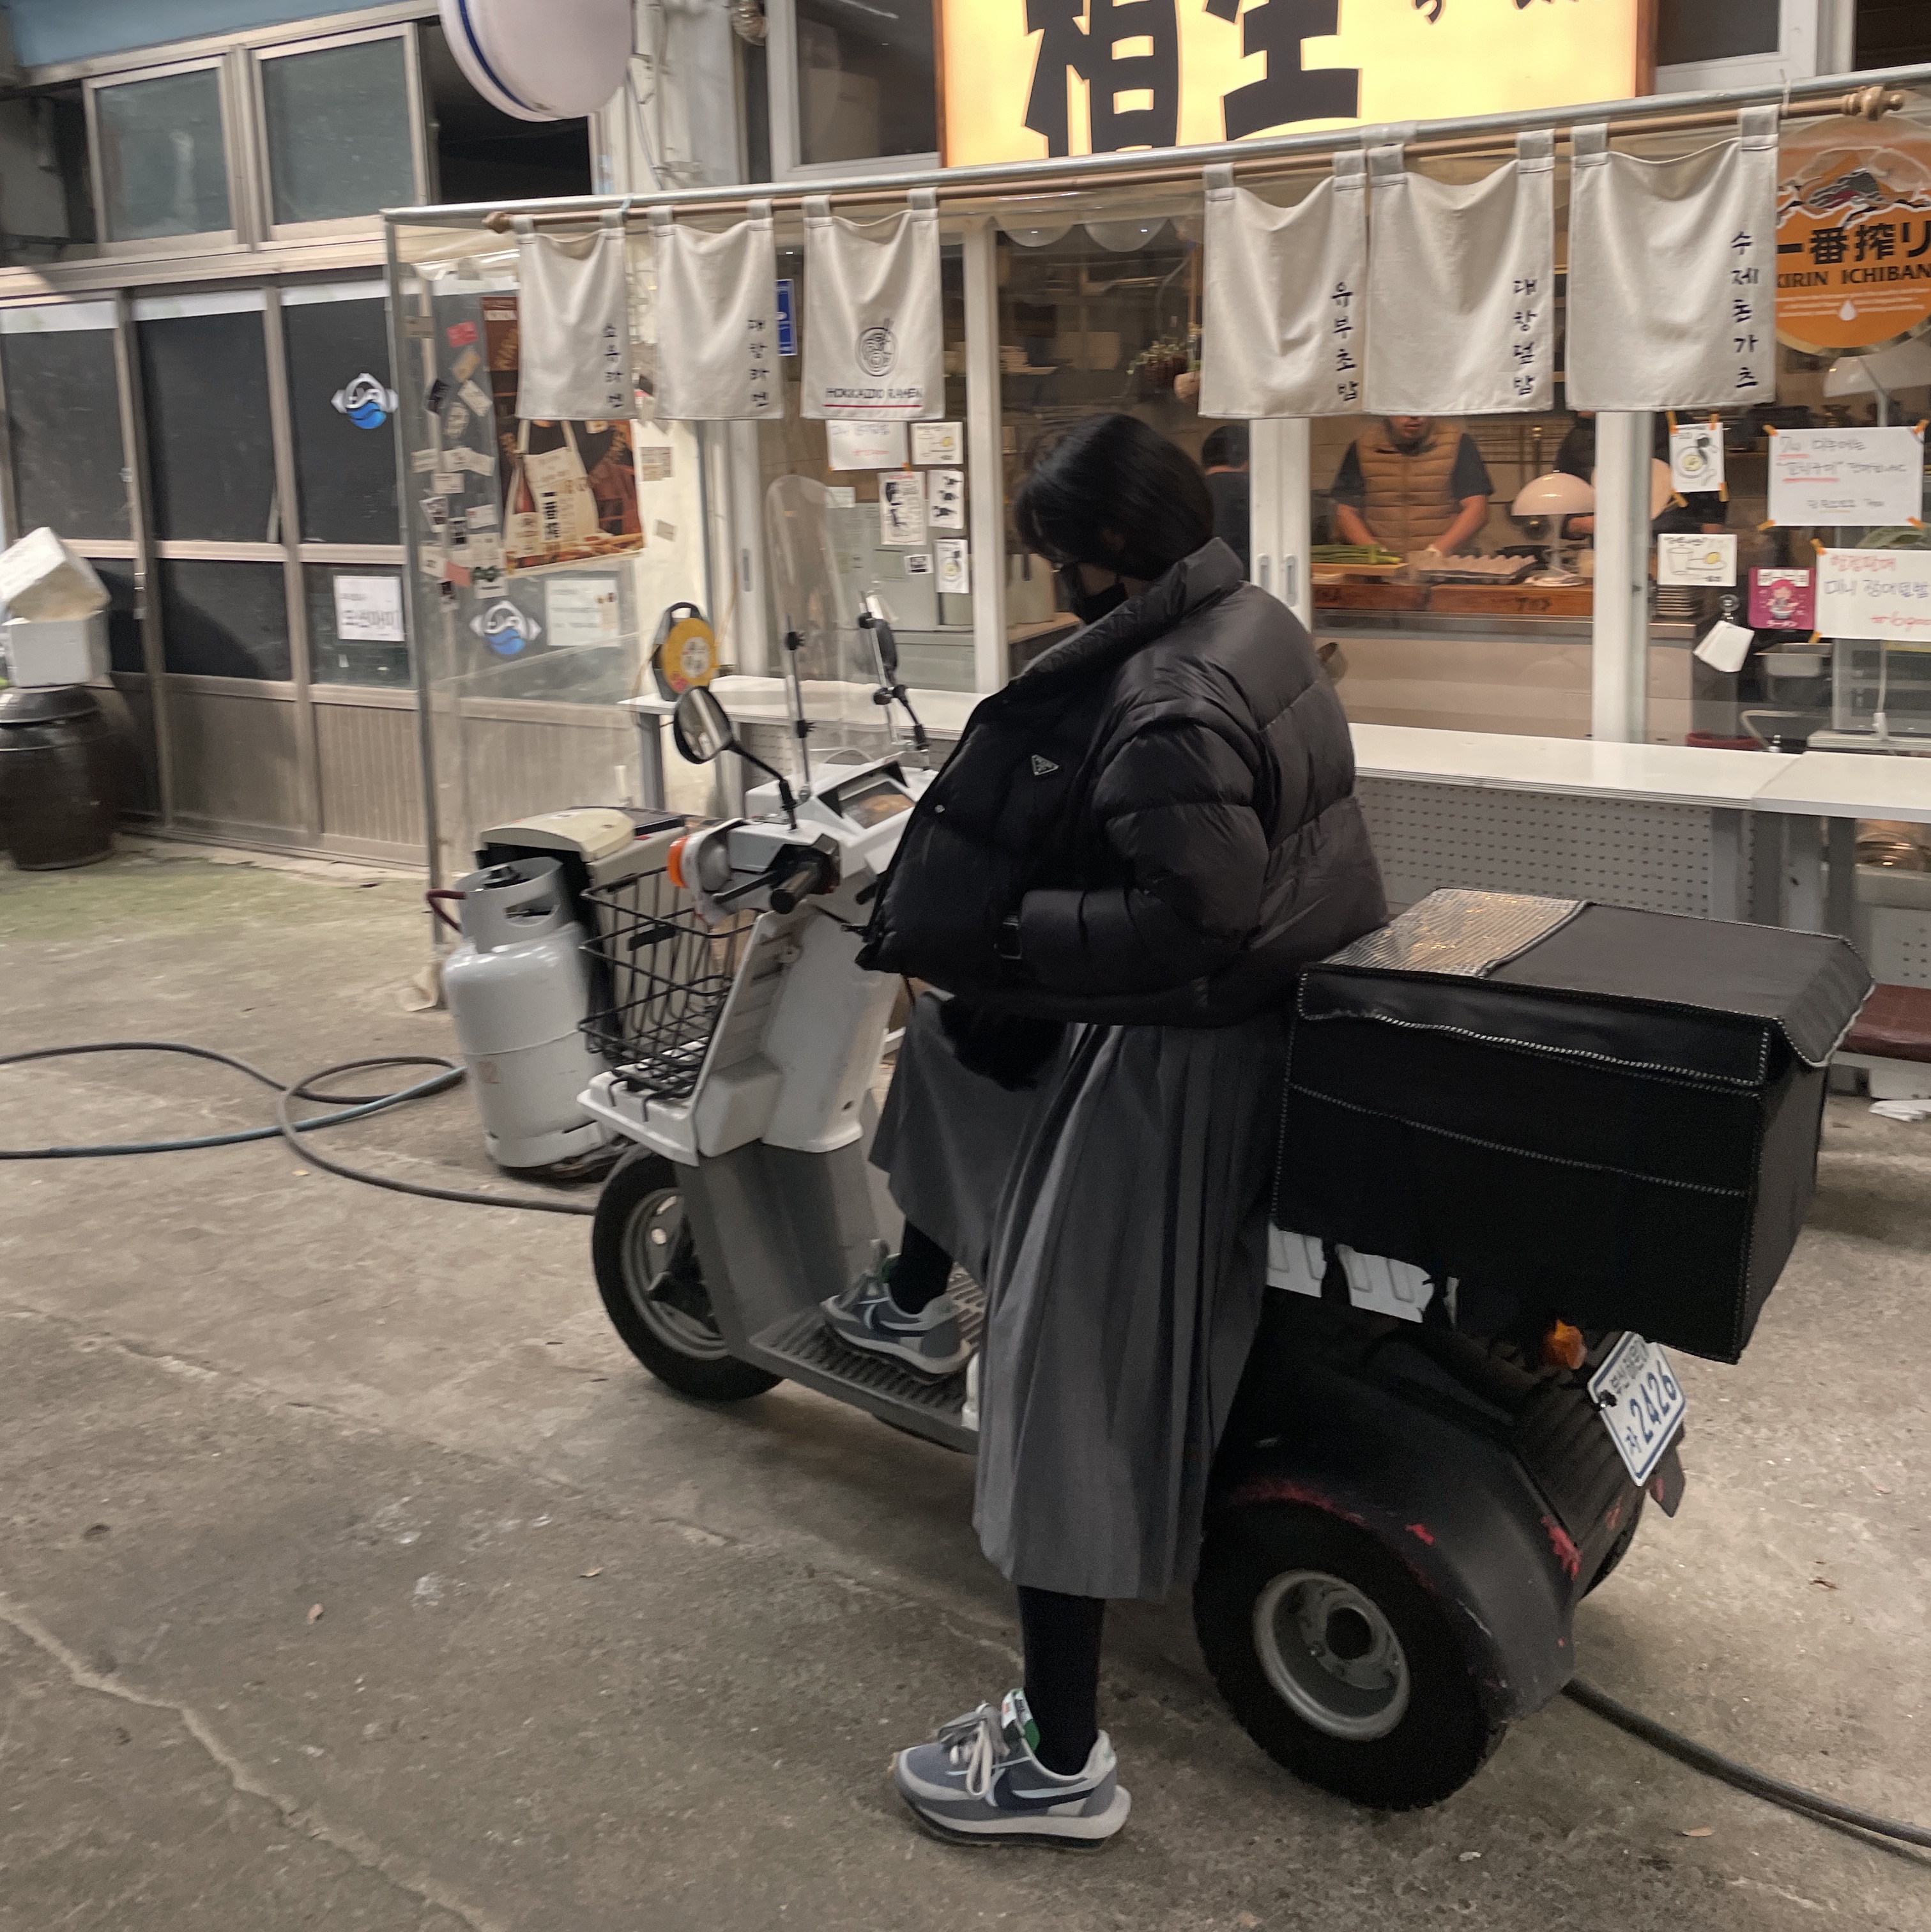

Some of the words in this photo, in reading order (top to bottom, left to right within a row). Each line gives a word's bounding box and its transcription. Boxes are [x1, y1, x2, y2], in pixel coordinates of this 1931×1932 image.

[1777, 221, 1931, 264] 一番搾り
[1842, 264, 1931, 284] ICHIBAN
[1331, 281, 1360, 401] 유부초밥
[1513, 279, 1538, 395] 대창덮밥
[1731, 231, 1759, 388] 수제돈가츠
[888, 388, 923, 399] RAMEN
[1630, 1360, 1677, 1445] 2426
